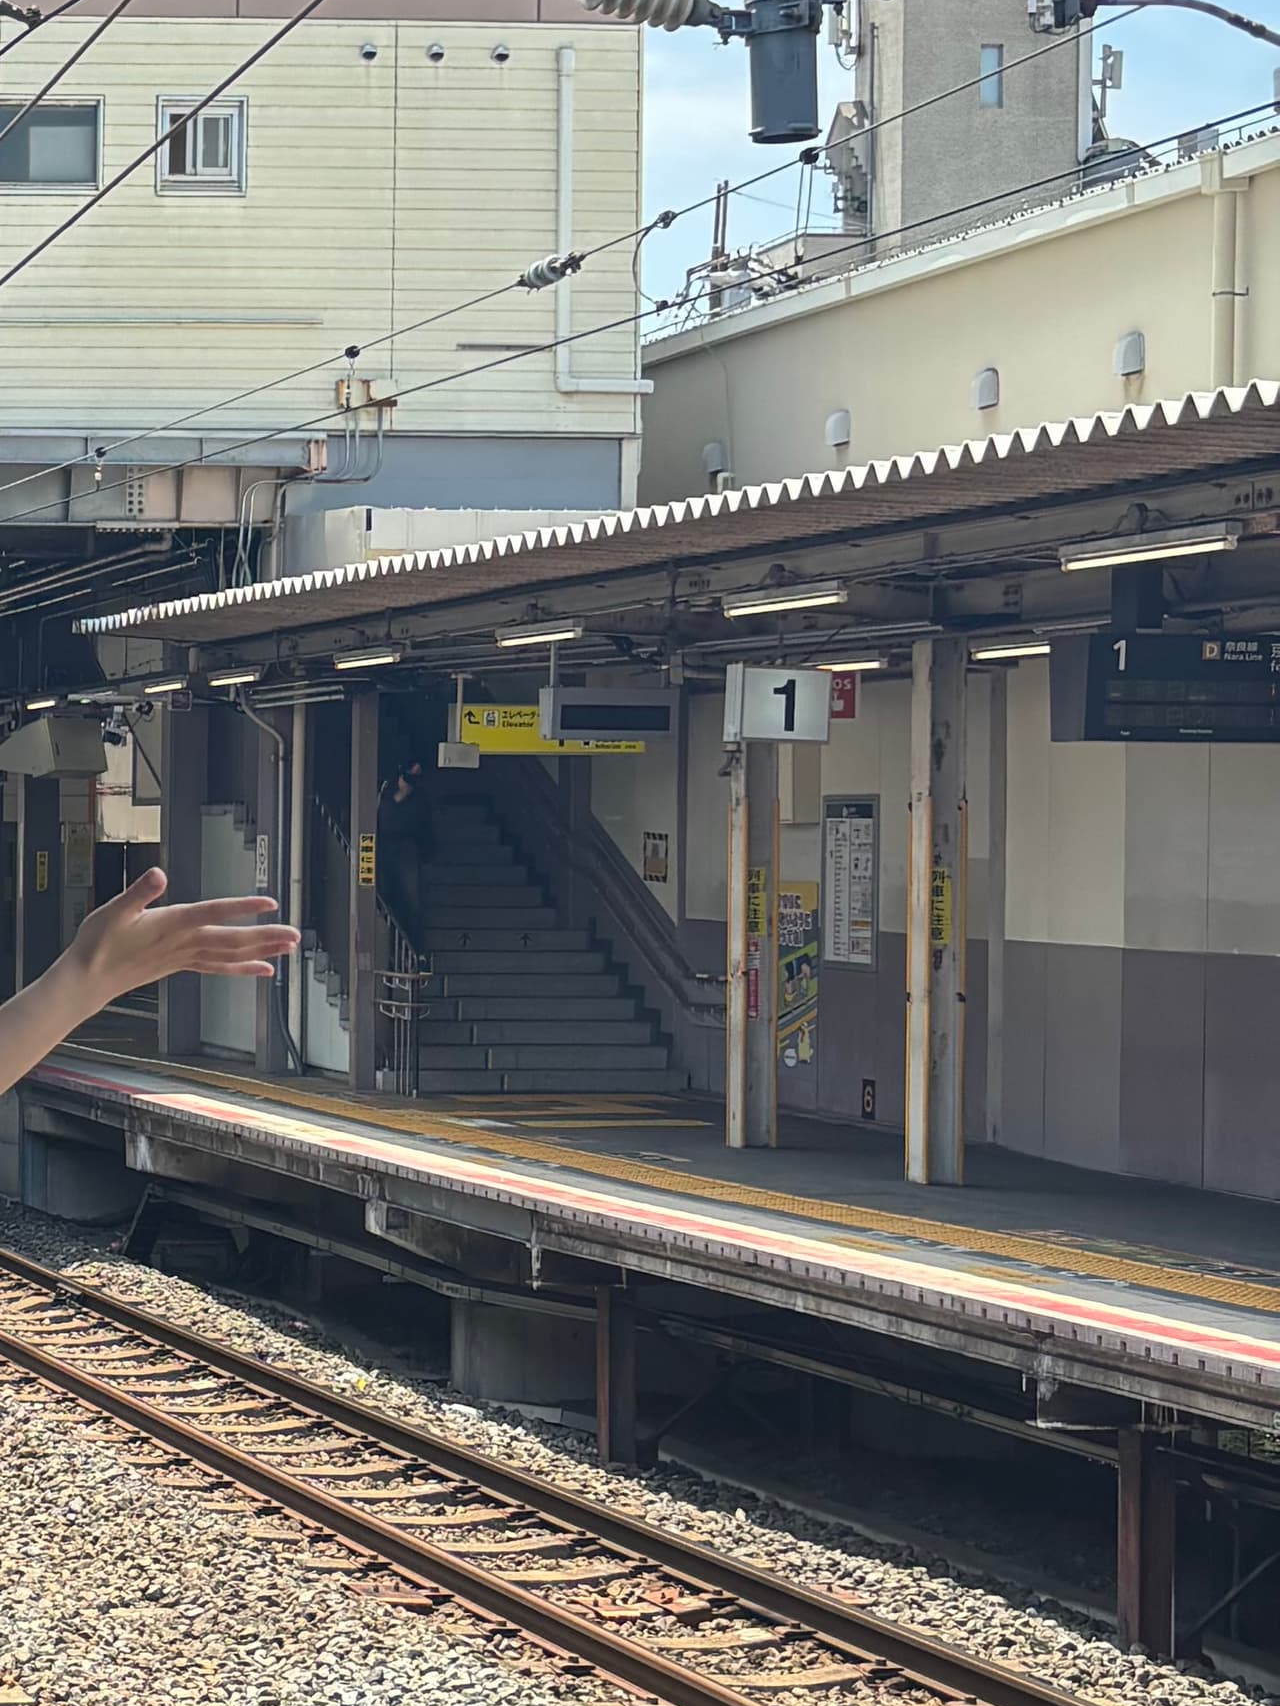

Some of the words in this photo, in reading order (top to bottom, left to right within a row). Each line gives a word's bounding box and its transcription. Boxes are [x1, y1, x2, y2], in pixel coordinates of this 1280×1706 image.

[1113, 639, 1128, 671] 1
[832, 678, 853, 690] OS
[772, 679, 798, 732] 1
[864, 1085, 873, 1113] 6
